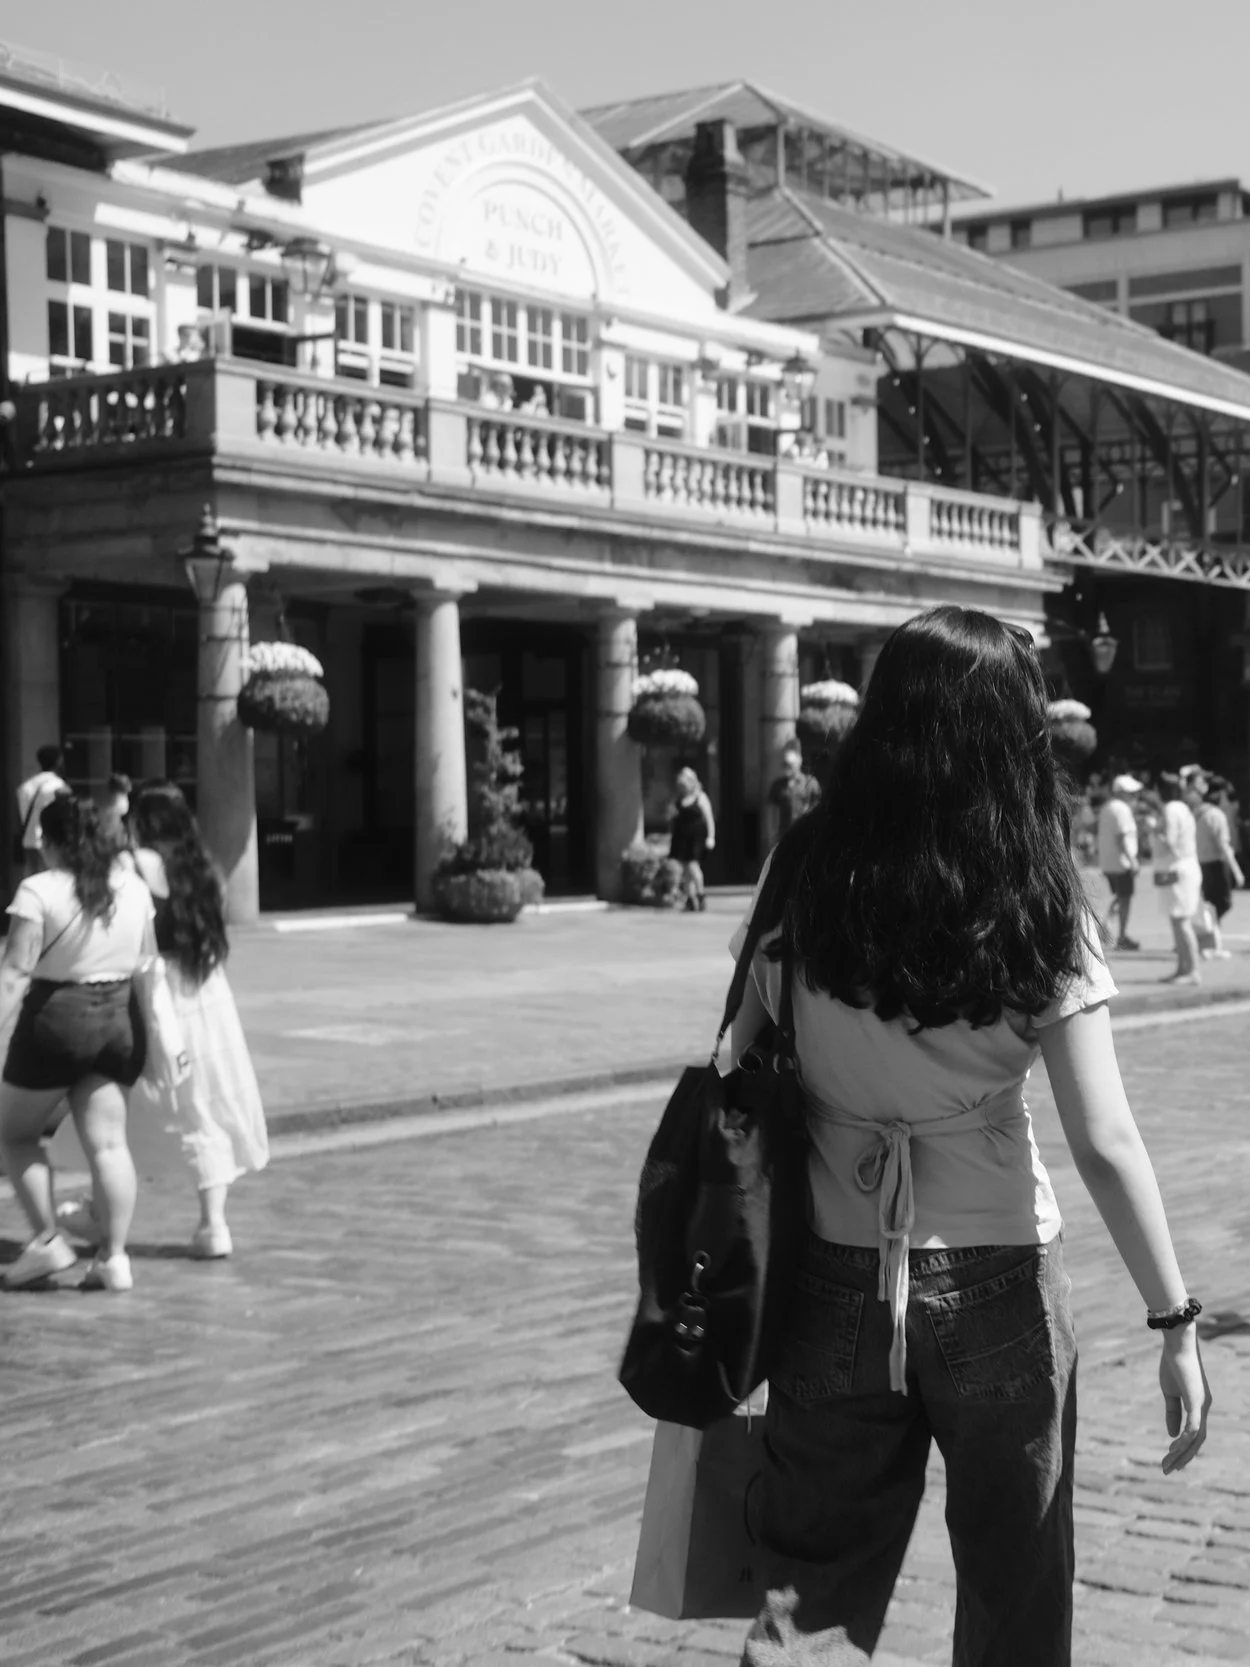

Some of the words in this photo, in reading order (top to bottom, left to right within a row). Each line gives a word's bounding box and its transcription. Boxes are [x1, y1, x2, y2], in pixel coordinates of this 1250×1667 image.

[414, 138, 473, 248] COVENT
[482, 199, 563, 241] PUNCH
[483, 238, 501, 262] &
[506, 242, 563, 277] JUDY
